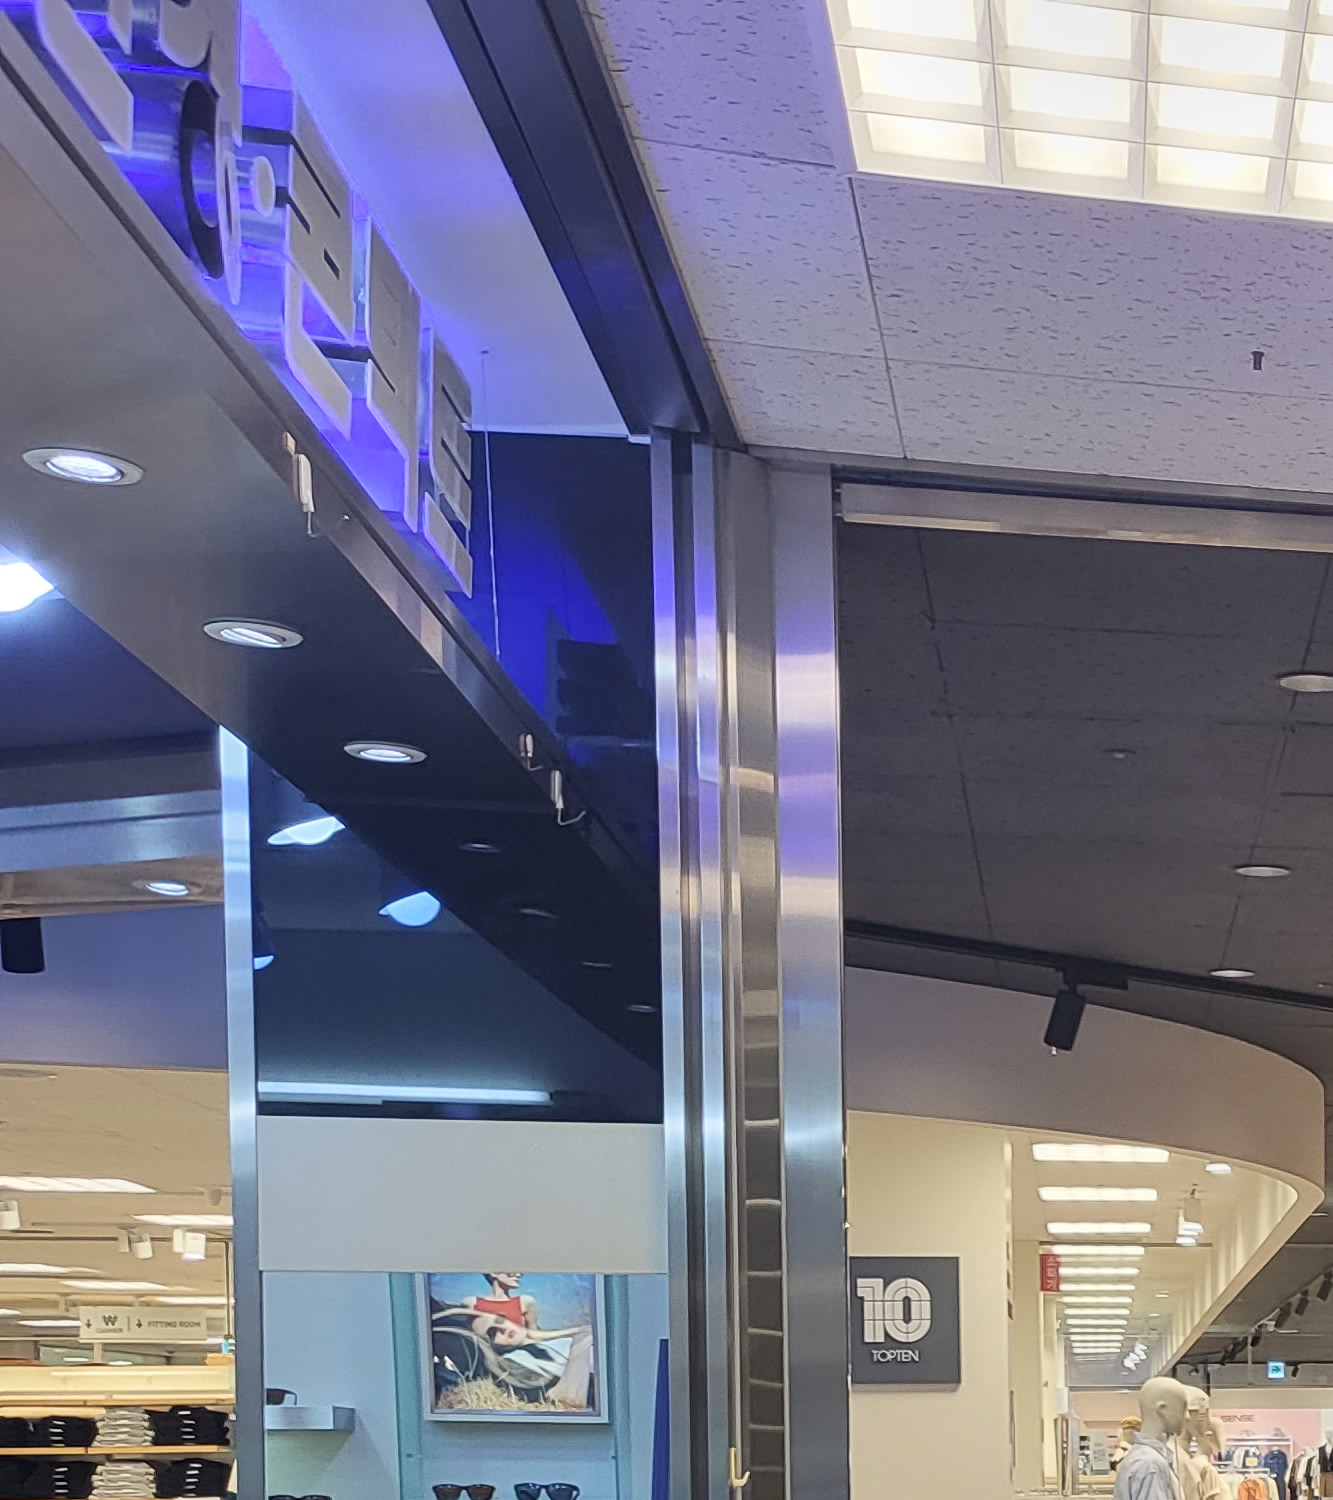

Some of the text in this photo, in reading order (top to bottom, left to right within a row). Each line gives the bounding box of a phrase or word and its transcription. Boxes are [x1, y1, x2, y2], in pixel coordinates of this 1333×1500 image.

[856, 1278, 932, 1344] 10
[147, 1320, 201, 1328] FITTING ROOM
[871, 1349, 920, 1362] TOPTEN
